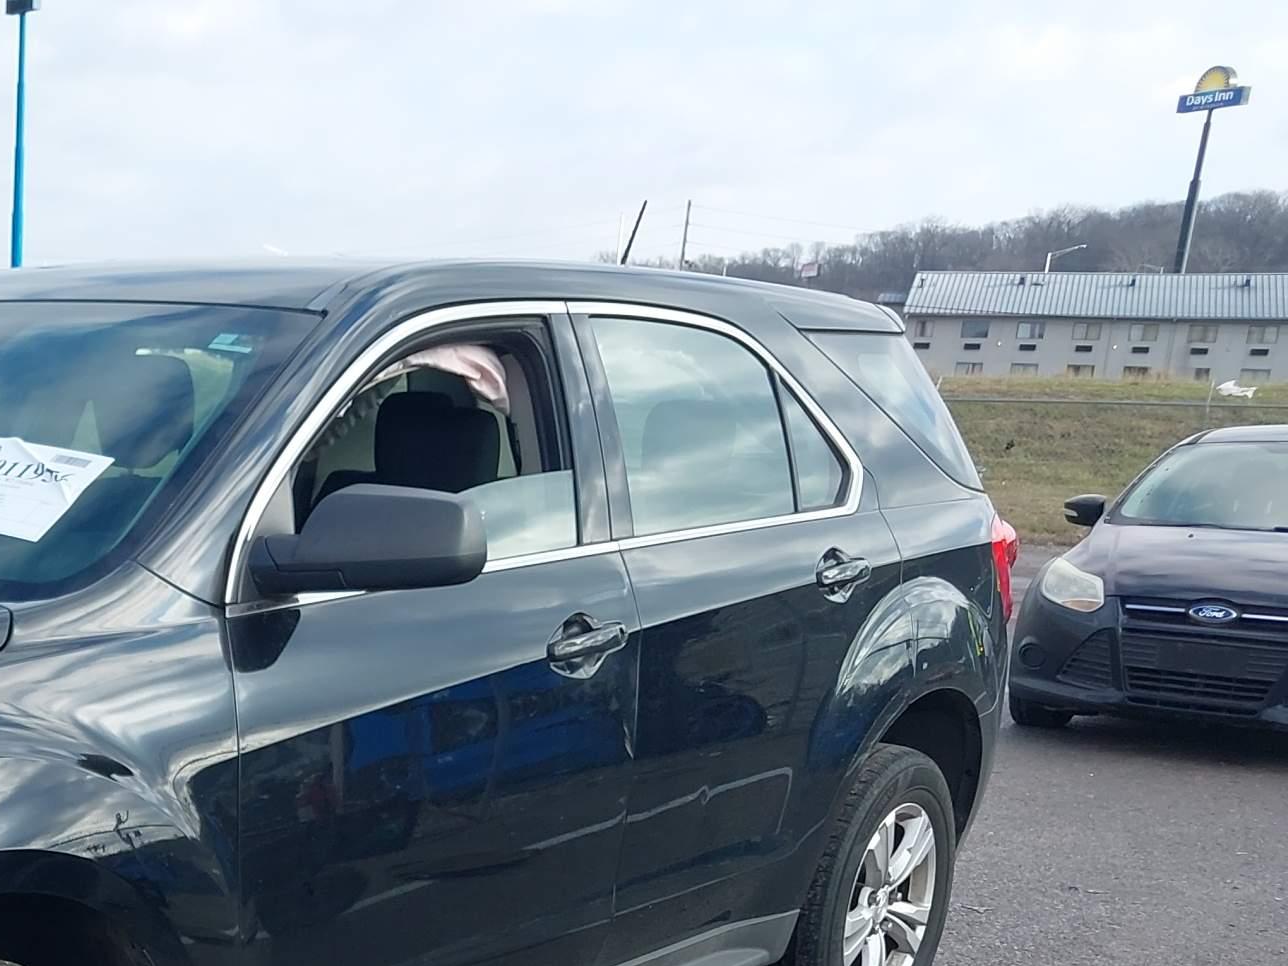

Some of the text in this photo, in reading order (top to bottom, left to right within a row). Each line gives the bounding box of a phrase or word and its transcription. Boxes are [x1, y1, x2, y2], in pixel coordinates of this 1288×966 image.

[1186, 91, 1234, 106] Days Inn
[1198, 607, 1227, 618] Ford
